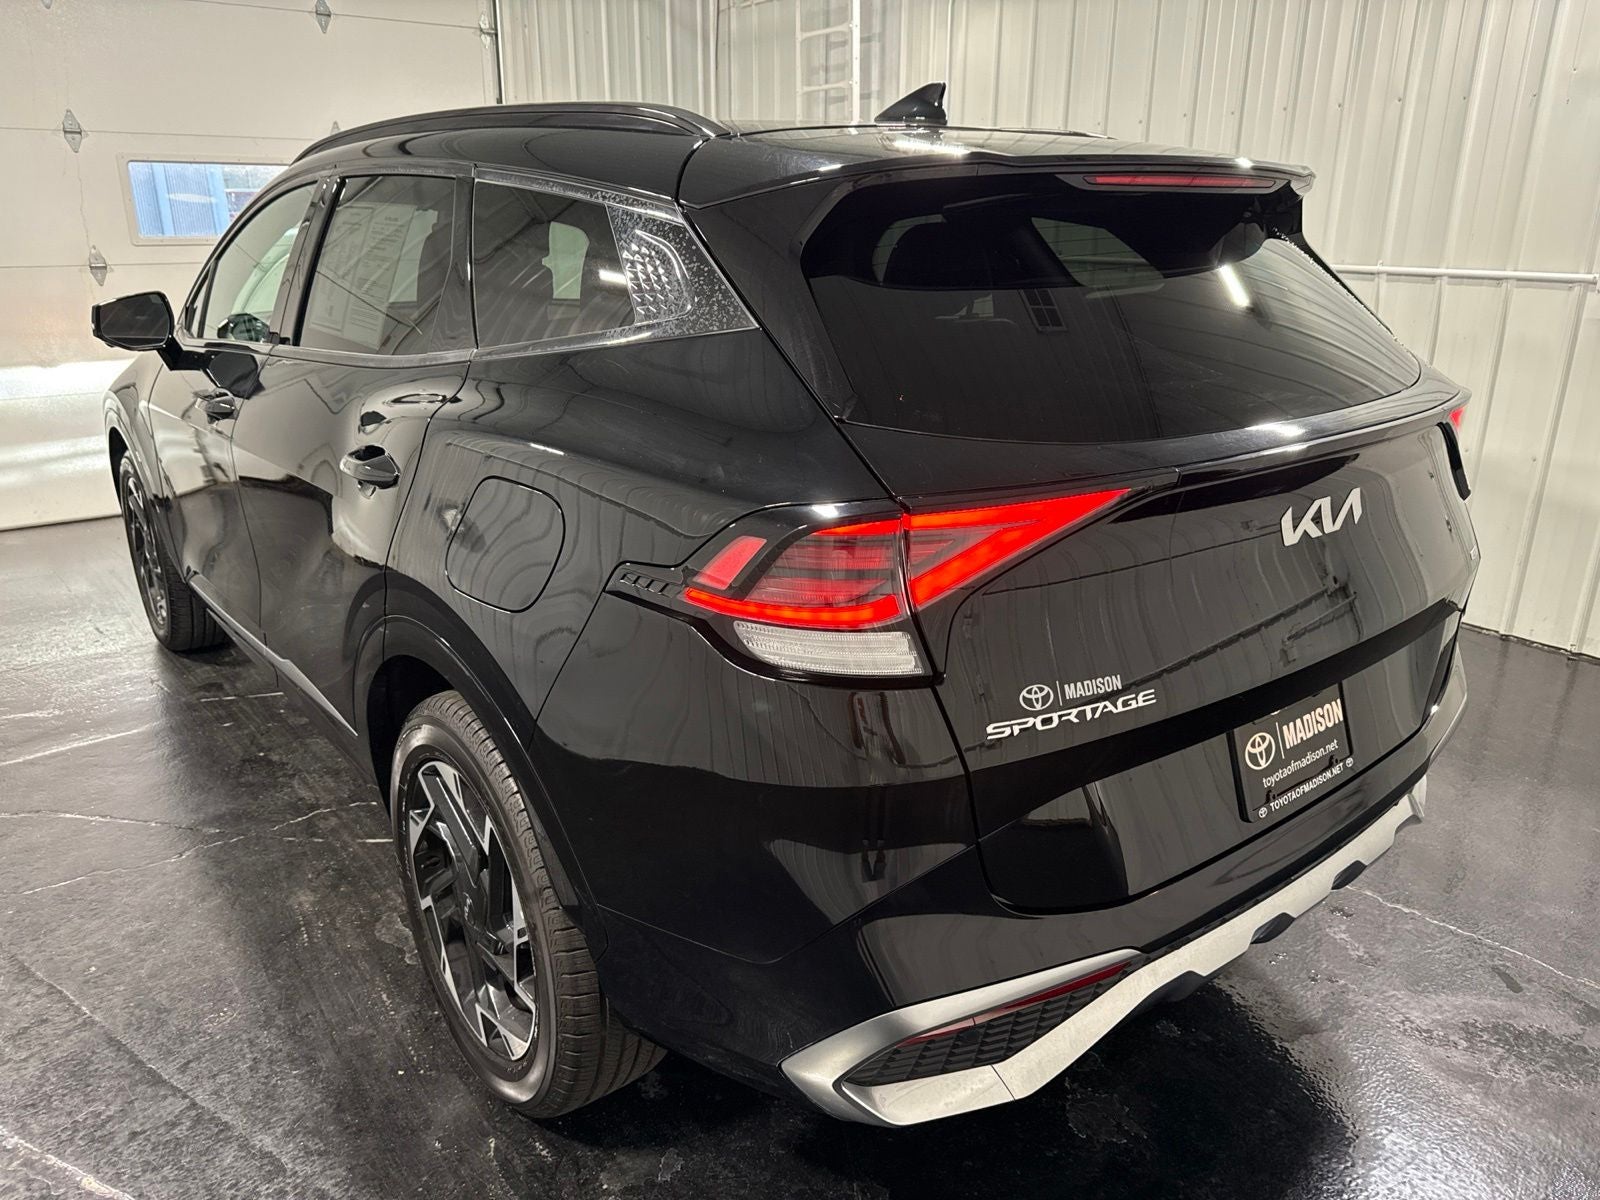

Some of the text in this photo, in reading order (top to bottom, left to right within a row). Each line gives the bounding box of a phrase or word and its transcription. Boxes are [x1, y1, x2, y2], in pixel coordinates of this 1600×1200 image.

[1281, 487, 1362, 547] KIA
[1064, 674, 1122, 700] MADISON
[985, 689, 1157, 740] SPORTAGE
[1282, 698, 1344, 749] MADISON
[1262, 739, 1339, 788] toyotaofmadison.net
[1270, 762, 1344, 812] TOYOTAOFMADISON.NET
